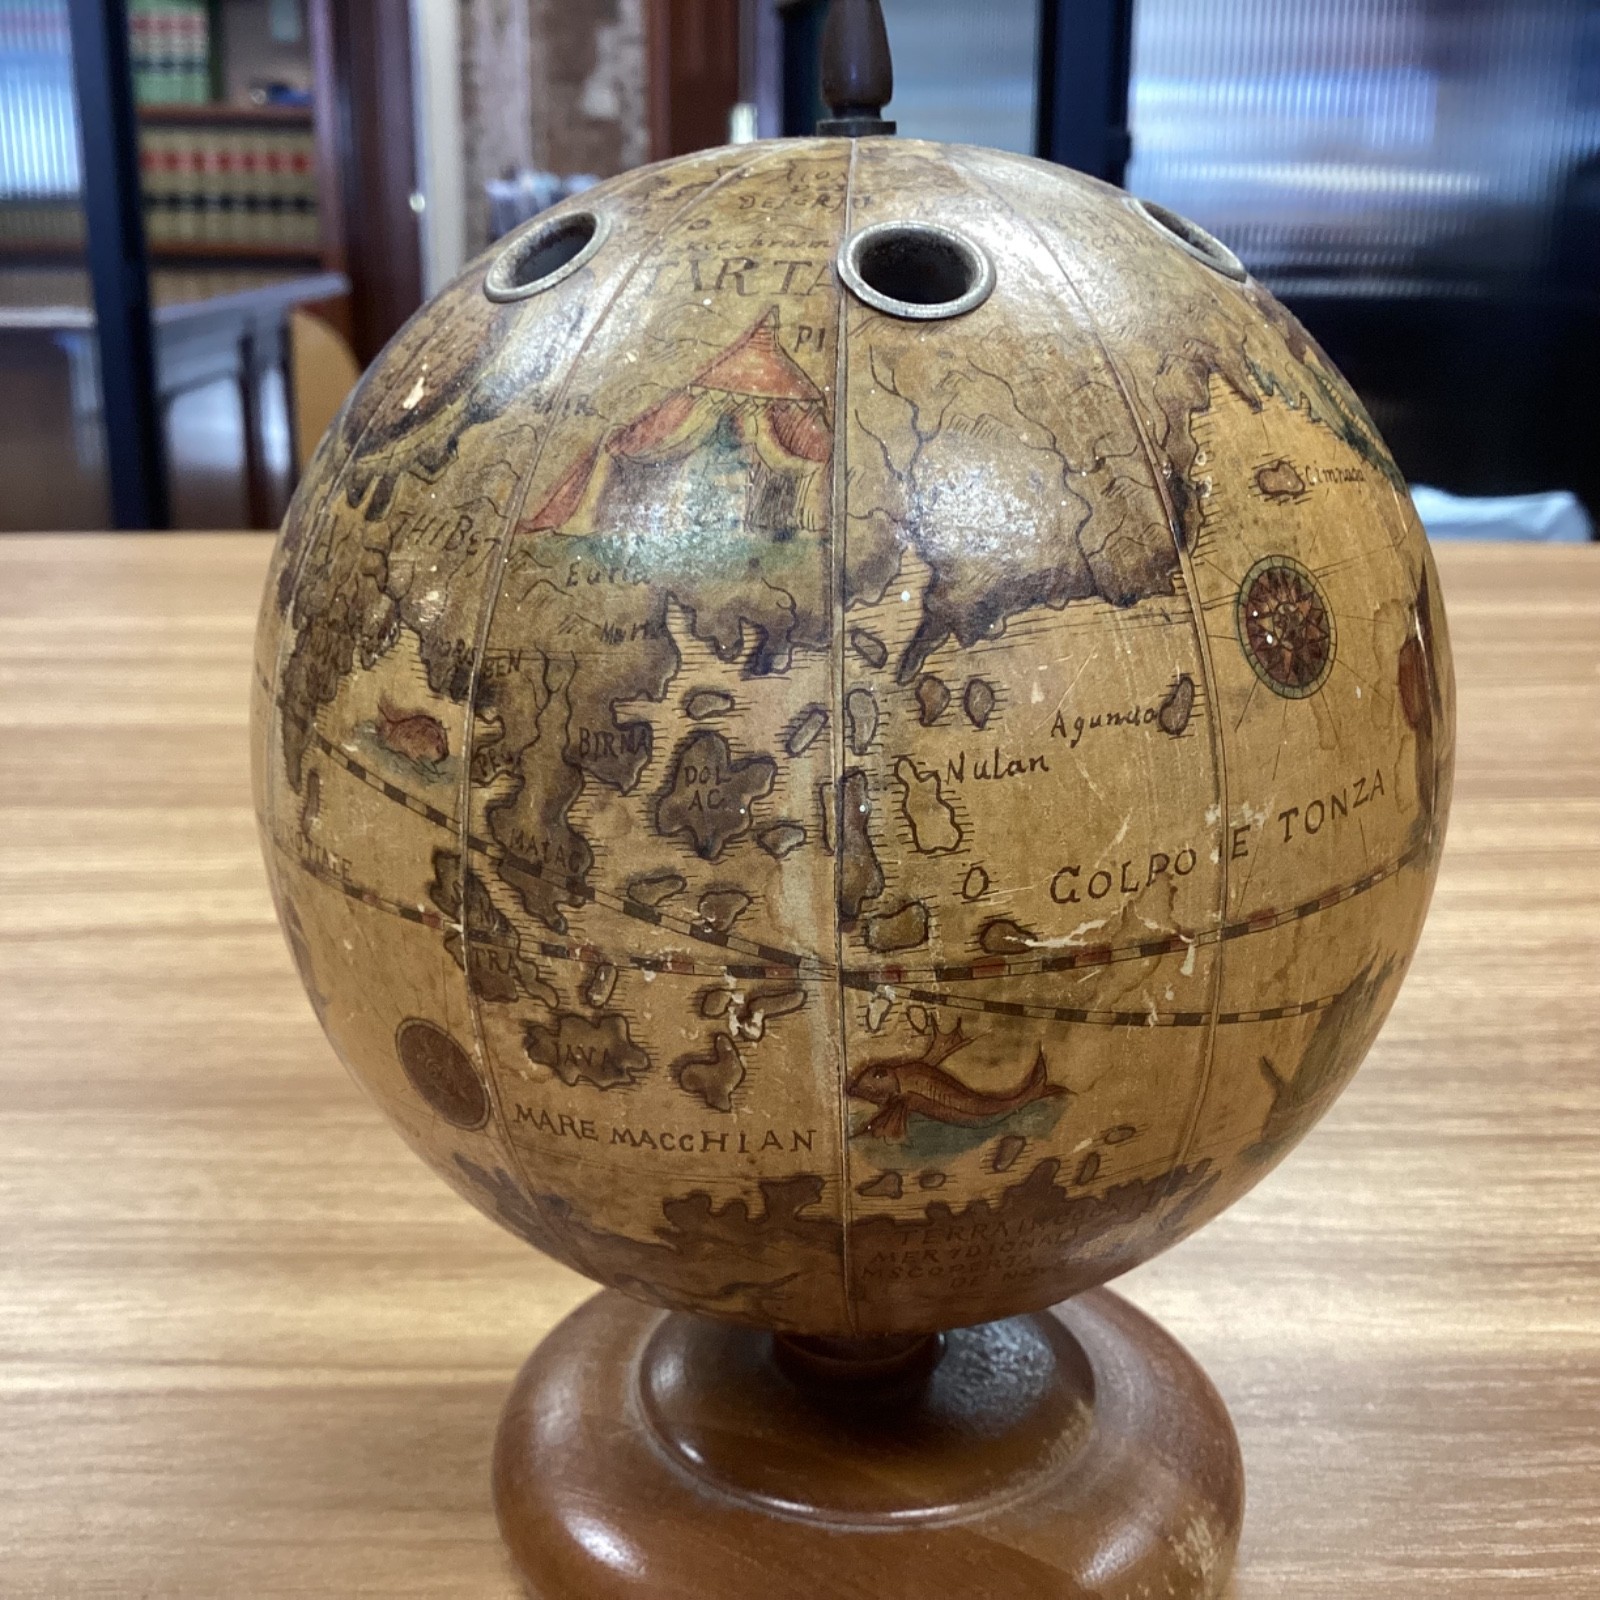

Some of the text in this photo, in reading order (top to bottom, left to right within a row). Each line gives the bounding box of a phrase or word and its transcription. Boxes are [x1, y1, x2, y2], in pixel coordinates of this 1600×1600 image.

[946, 748, 1050, 785] Nulan
[1278, 768, 1385, 844] TONZA
[514, 1103, 817, 1154] MARE MACCHIAN
